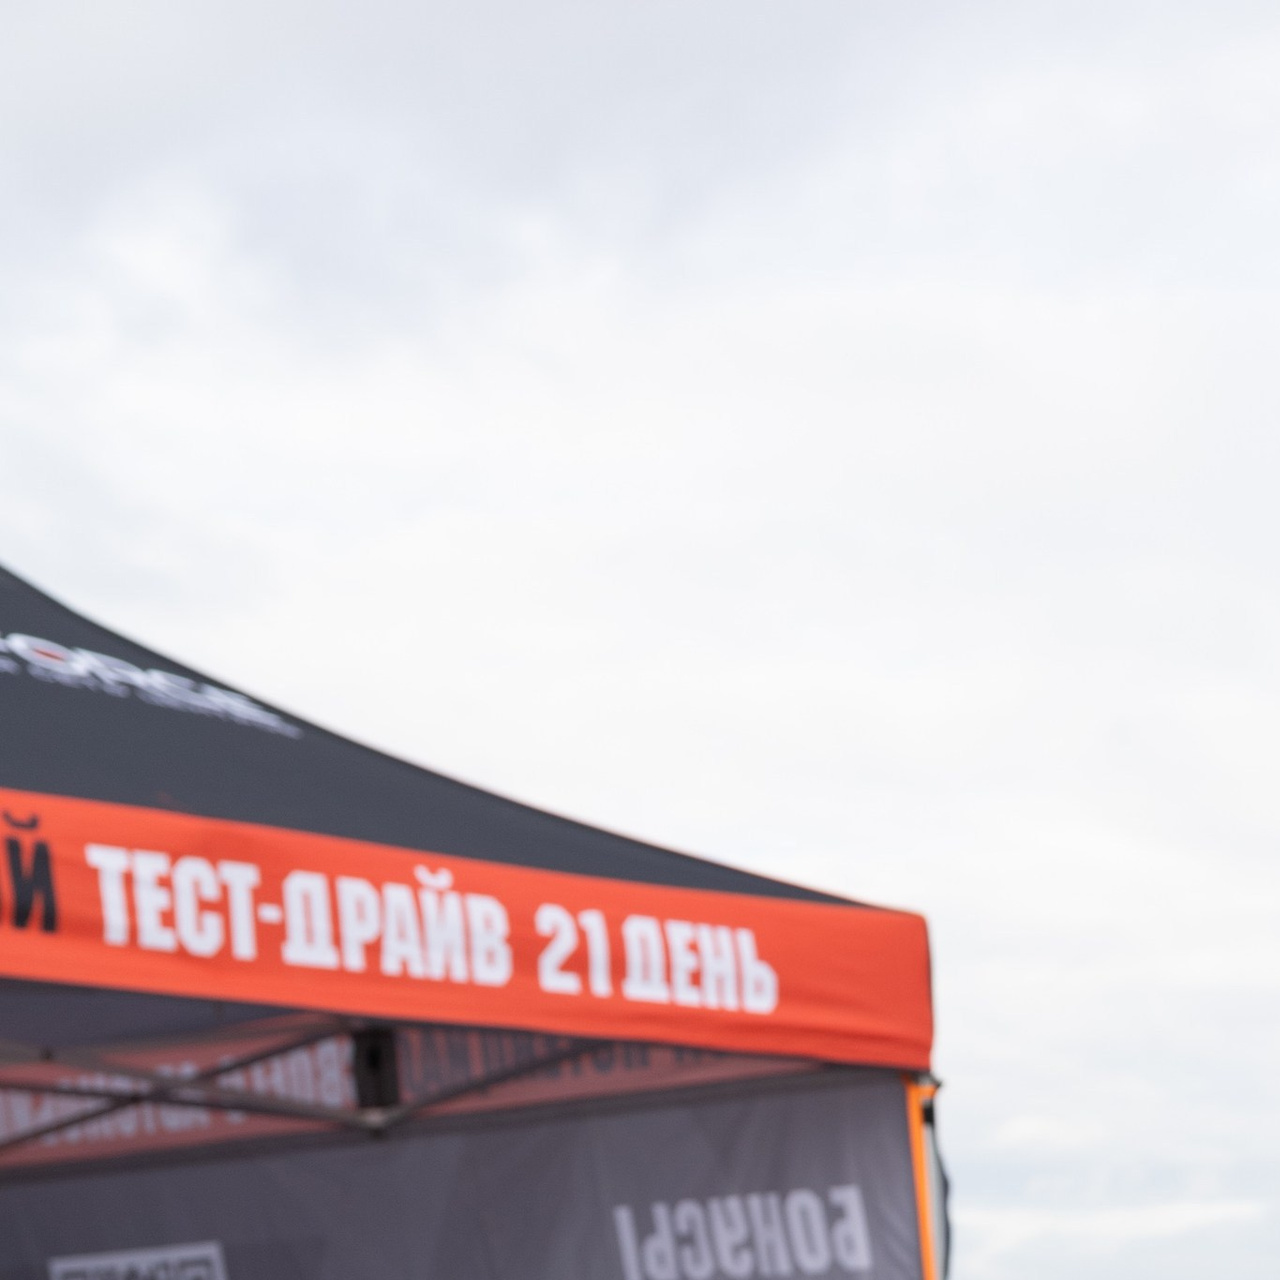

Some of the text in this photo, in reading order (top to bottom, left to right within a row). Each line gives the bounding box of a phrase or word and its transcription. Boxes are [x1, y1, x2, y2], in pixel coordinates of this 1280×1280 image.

[0, 811, 779, 1014] Й ТЕСТ-ДРАЙВ 21 ДЕНЬ
